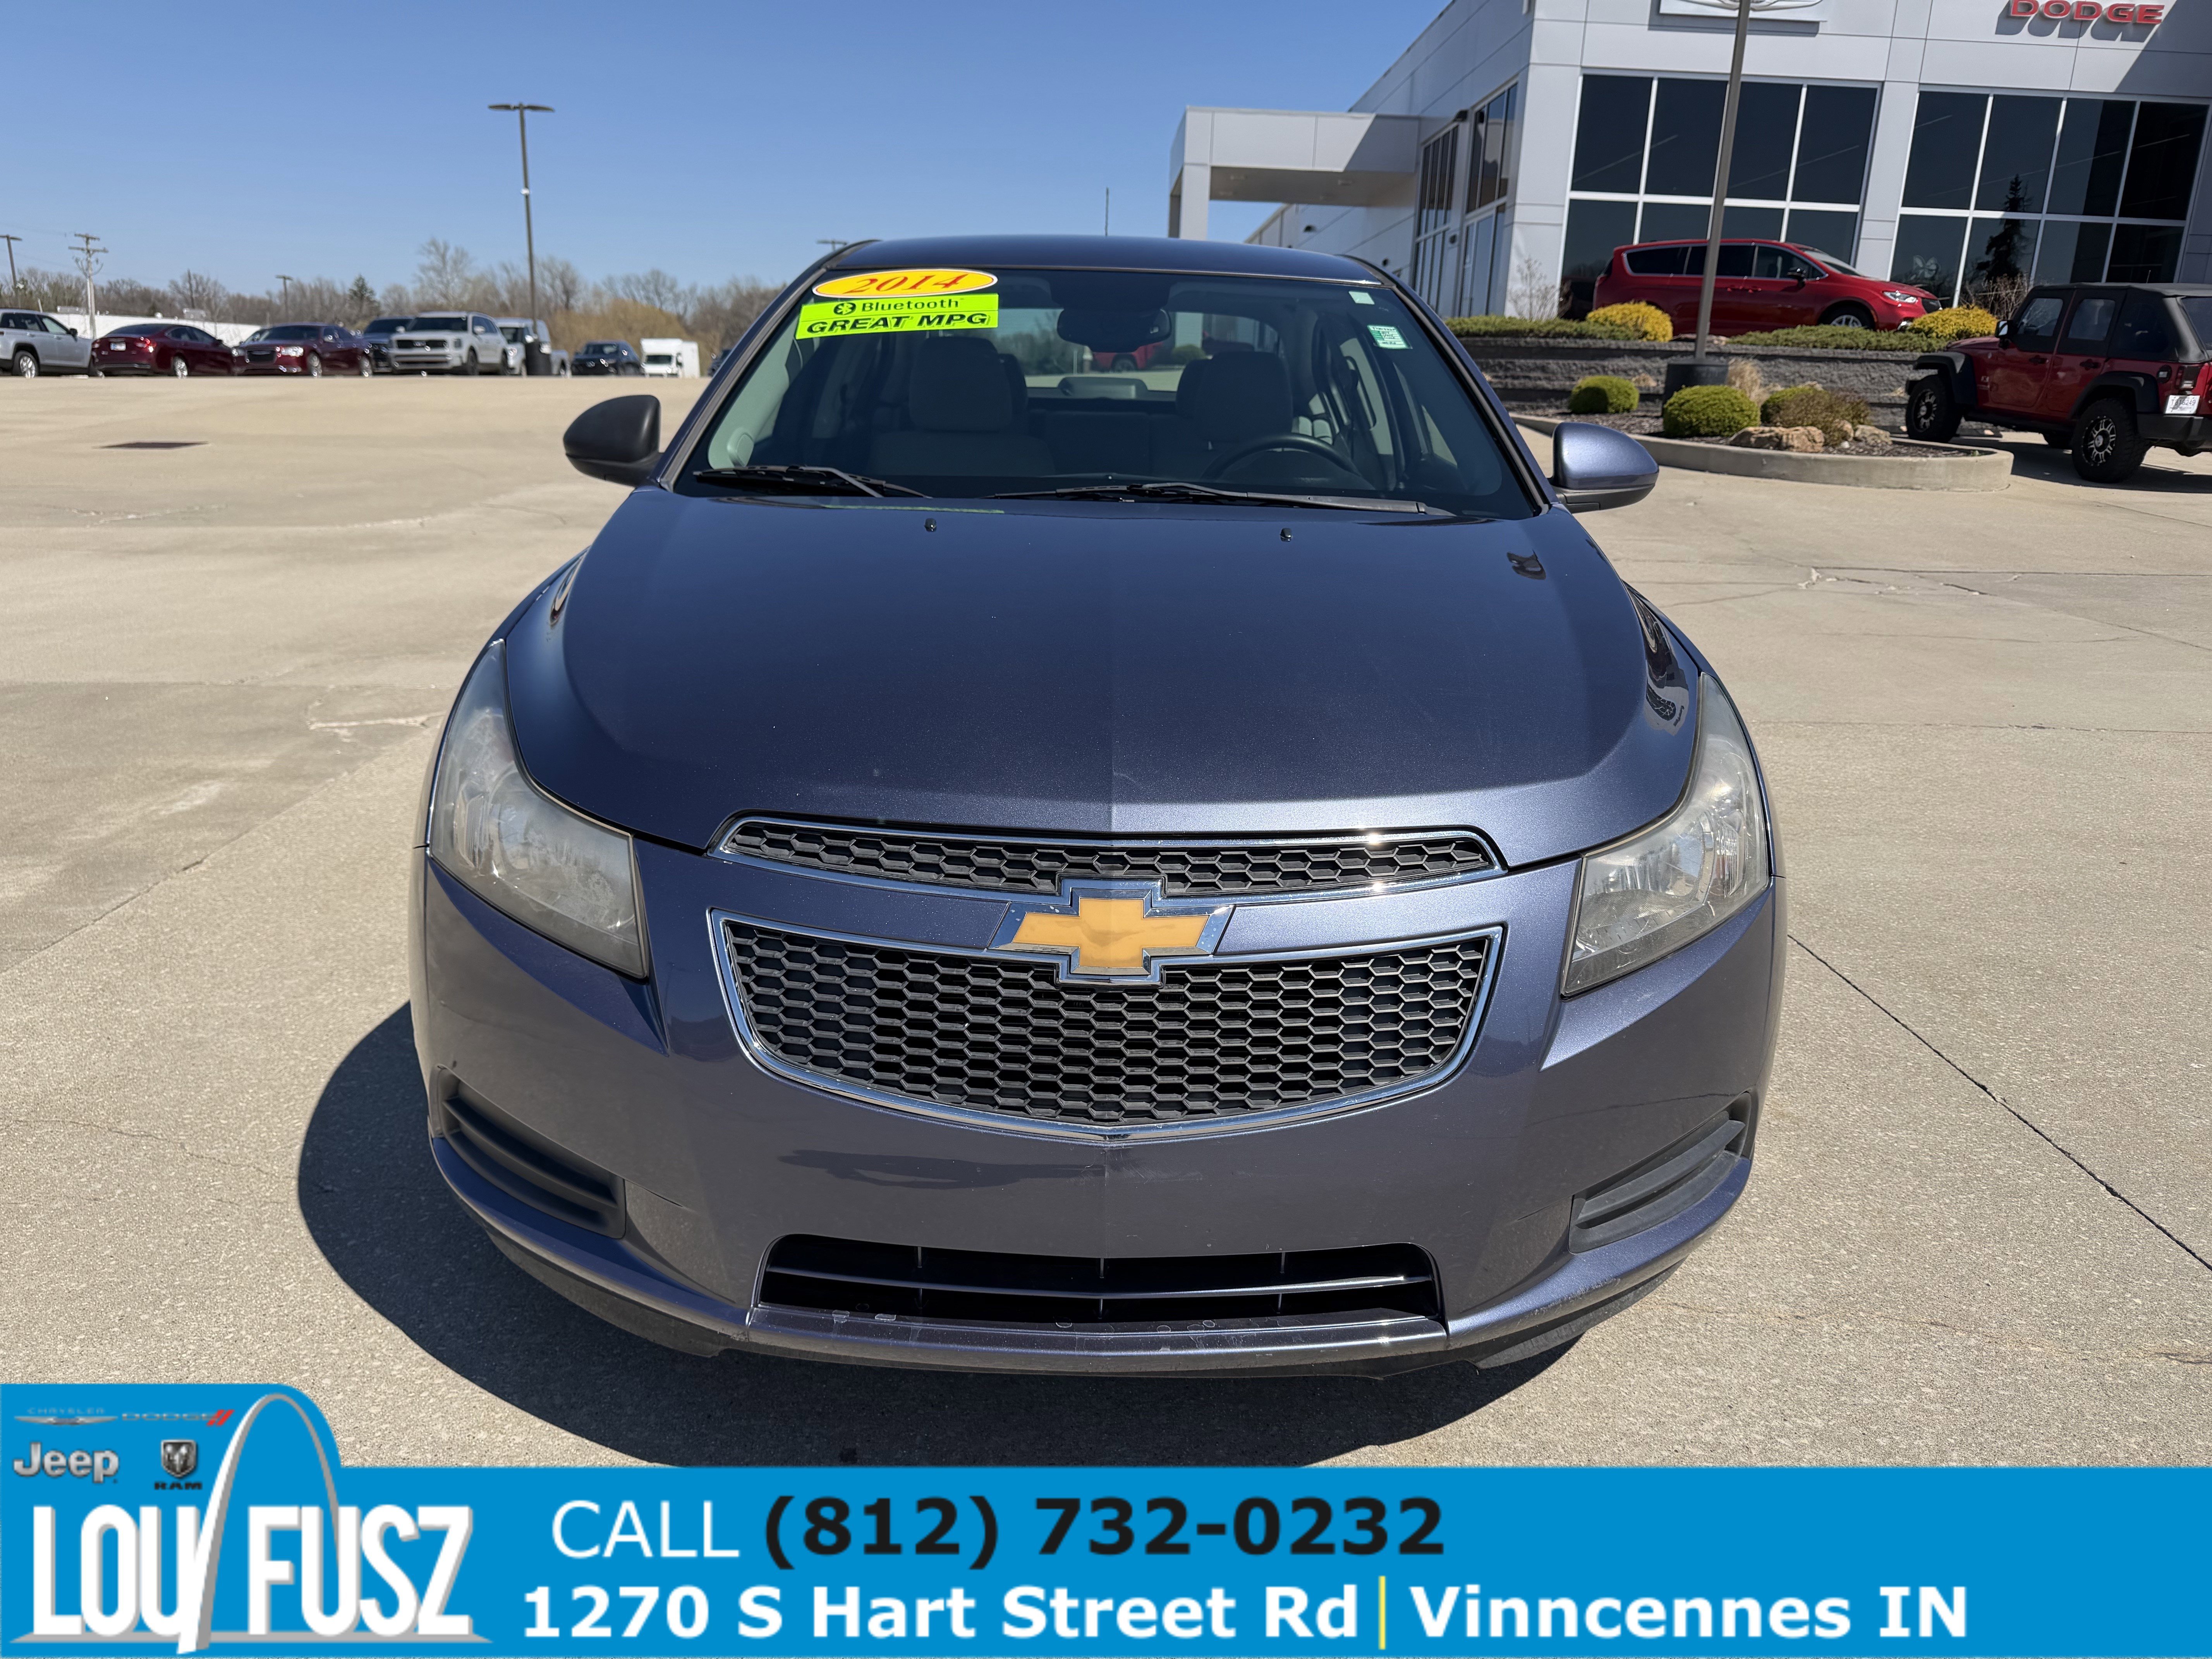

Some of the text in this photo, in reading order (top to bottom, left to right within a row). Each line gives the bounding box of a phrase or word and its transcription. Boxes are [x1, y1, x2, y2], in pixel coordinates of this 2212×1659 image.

[2011, 0, 2166, 24] DODGE
[844, 274, 969, 294] 2014
[862, 299, 958, 312] Bluetooth
[807, 313, 987, 334] GREAT MPG
